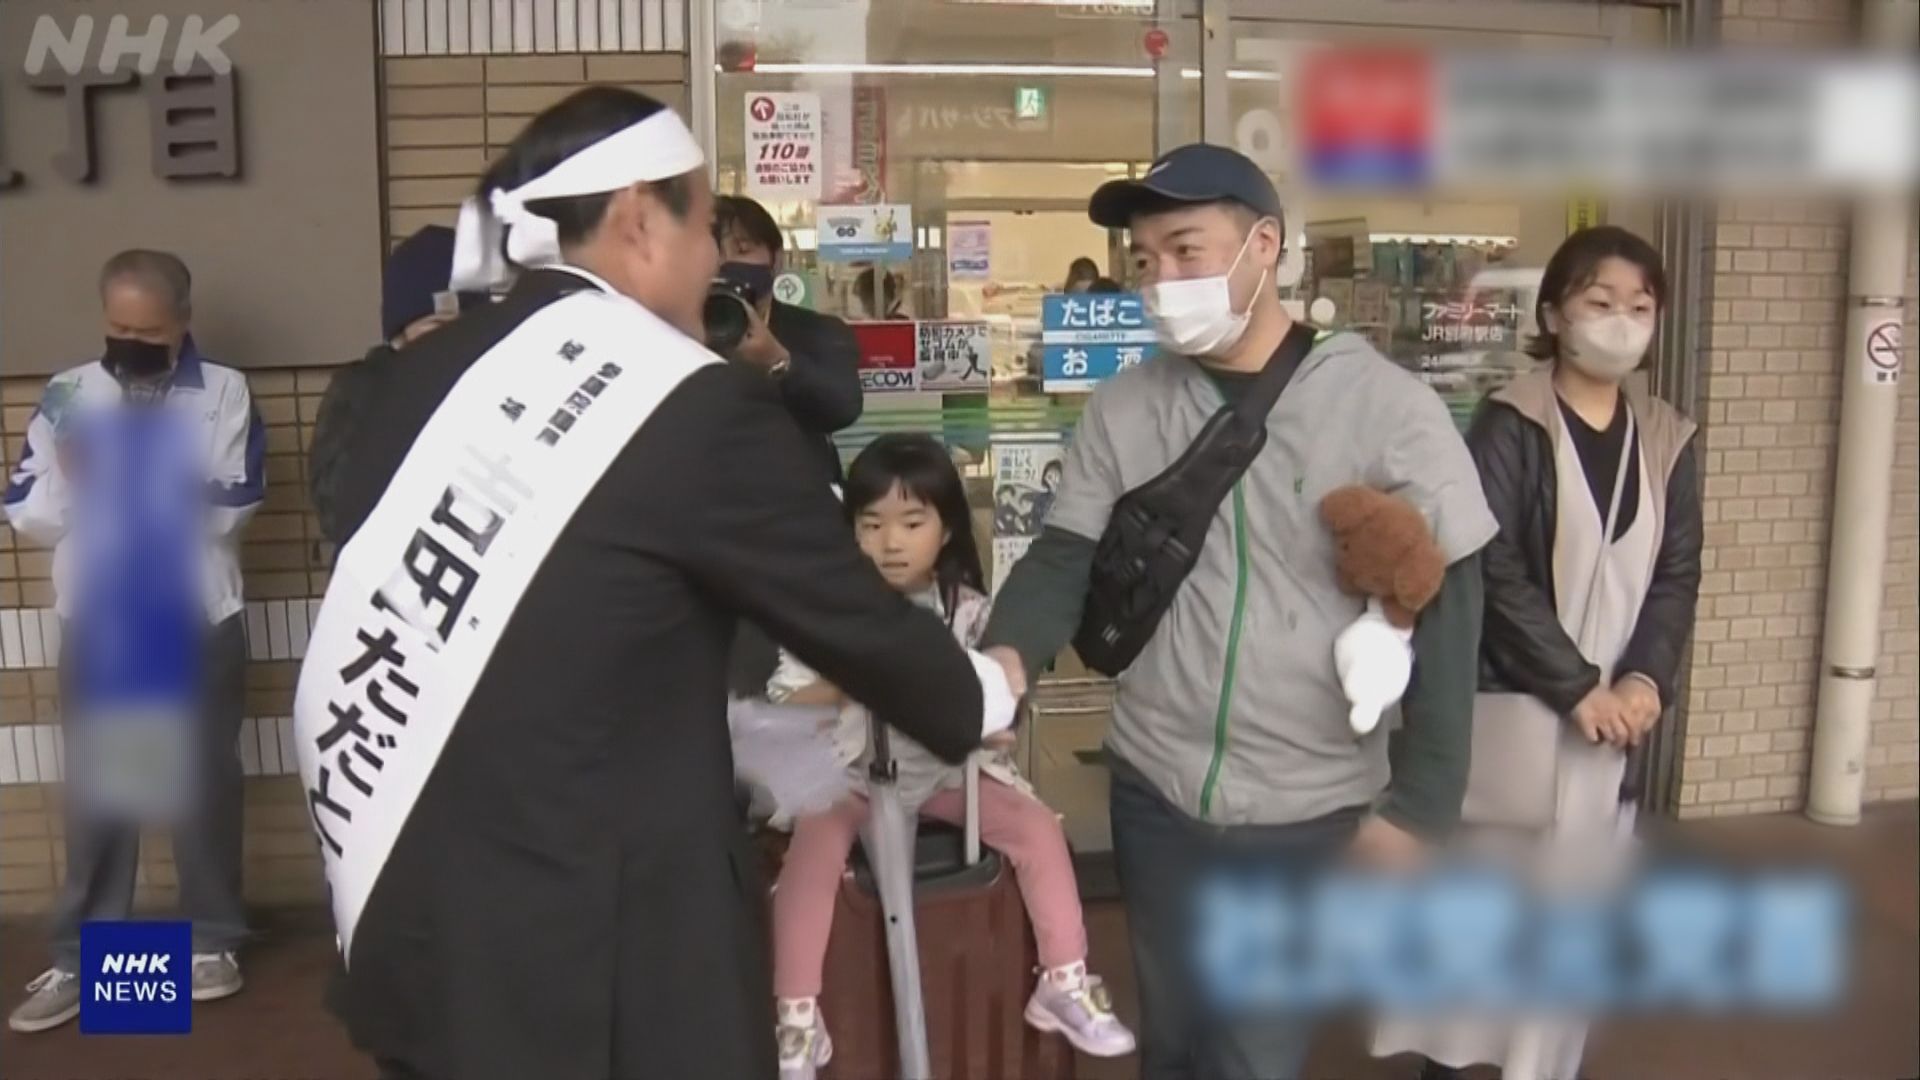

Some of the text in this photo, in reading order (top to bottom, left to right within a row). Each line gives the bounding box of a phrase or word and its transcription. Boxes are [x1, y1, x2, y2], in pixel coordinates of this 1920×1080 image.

[0, 60, 245, 190] 丁目
[1061, 298, 1142, 327] たばこ
[1422, 302, 1524, 320] ファミリーマート
[862, 370, 913, 387] ECOM
